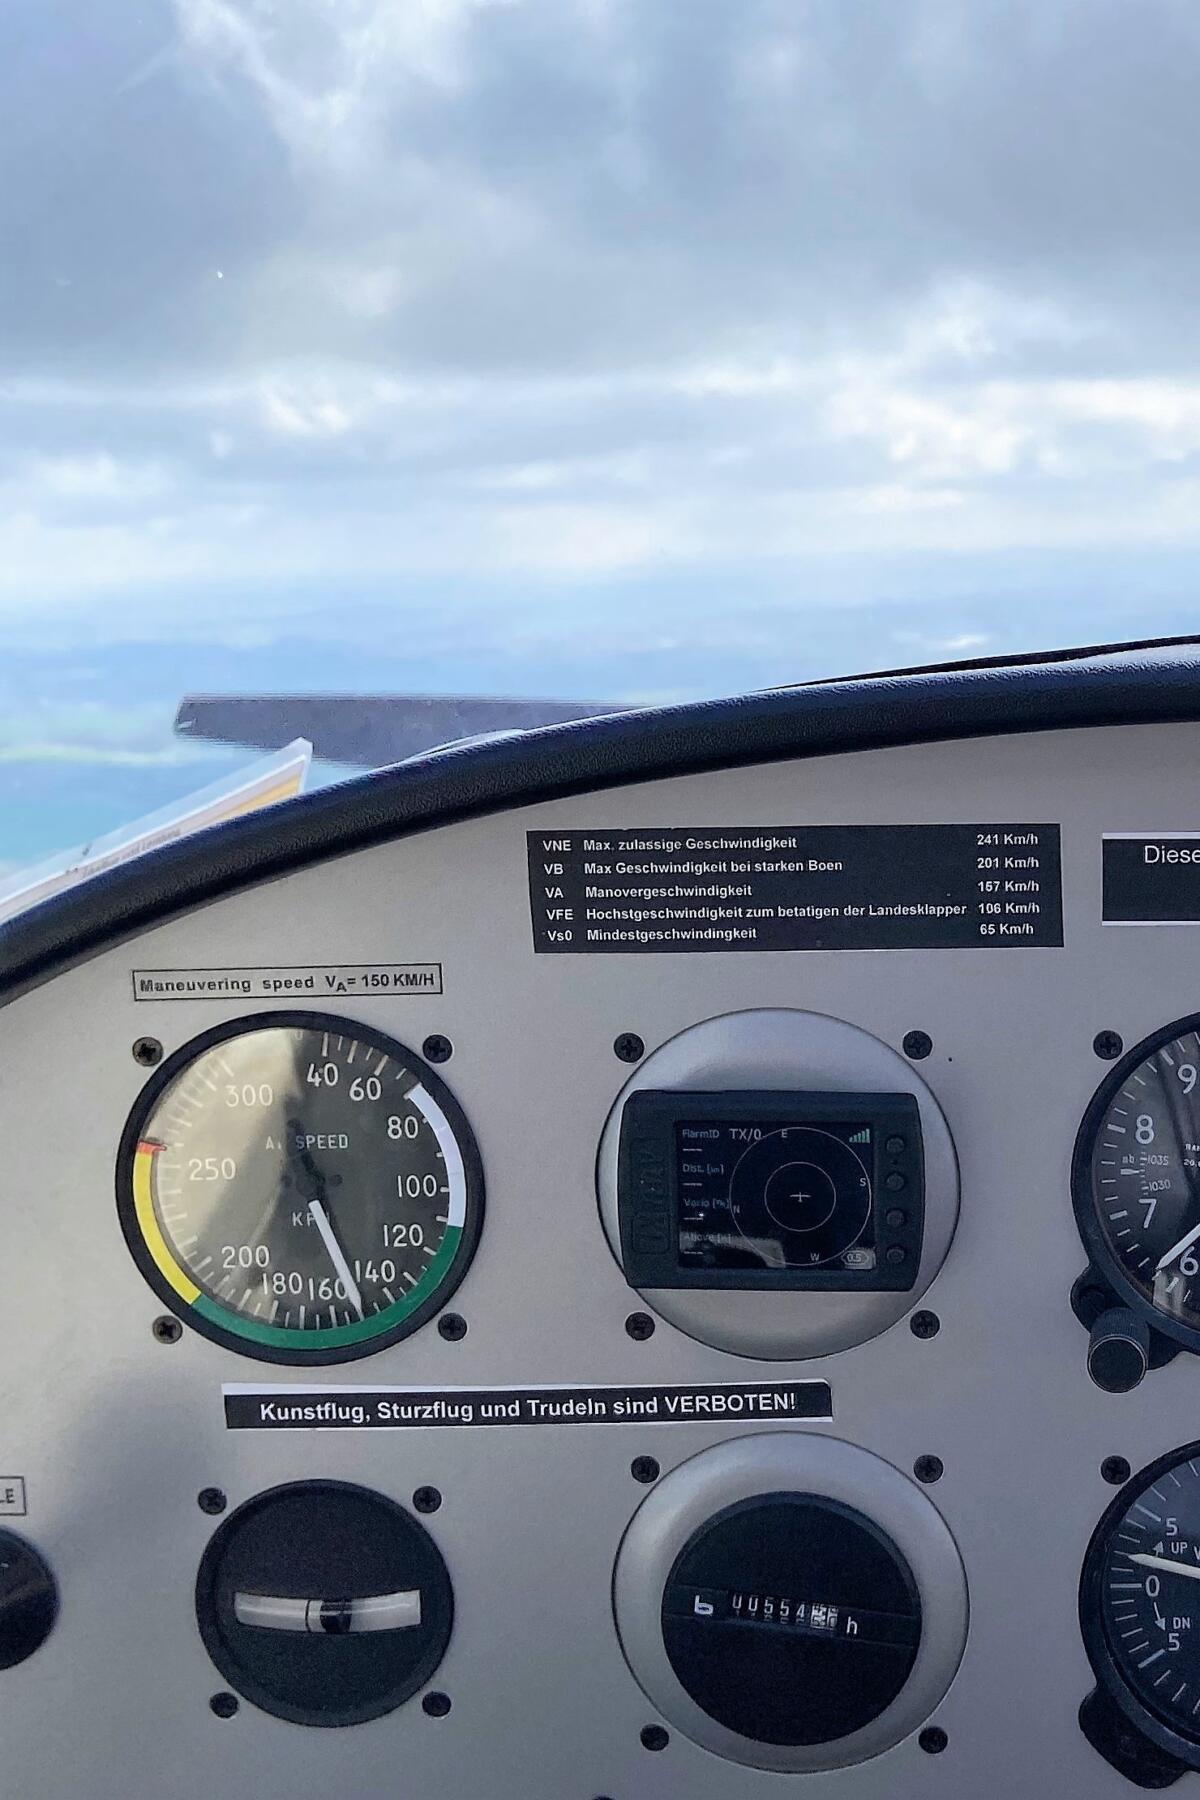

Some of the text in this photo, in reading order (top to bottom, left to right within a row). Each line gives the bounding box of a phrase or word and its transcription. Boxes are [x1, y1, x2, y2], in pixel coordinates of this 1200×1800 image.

[542, 839, 572, 852] VNE
[618, 837, 682, 854] zulassige
[685, 836, 798, 853] Geschwindigkeit
[976, 833, 1000, 846] 241
[1003, 832, 1039, 846] Km/h
[544, 855, 1040, 876] VB Max Geschwindigkeit bei starken Boen 201 Km/h
[545, 887, 564, 899] VA
[585, 883, 753, 900] Manovergeschwindigkeit
[1003, 879, 1040, 894] Km/h
[546, 901, 1041, 922] VFE Hochstgeschwindigkeit zum betatigen der Landesklapper 106 Km/h
[587, 926, 757, 943] Mindestgeschwindingkeit
[979, 923, 996, 936] 65
[999, 922, 1034, 936] Km/h
[140, 977, 251, 994] Maneuvering
[262, 975, 314, 992] speed
[361, 974, 390, 988] 150
[393, 972, 435, 988] KM/H
[306, 1062, 339, 1088] 40
[1177, 1063, 1198, 1094] 9
[225, 1084, 273, 1107] 300
[349, 1077, 382, 1102] 60
[387, 1116, 419, 1140] 80
[1134, 1114, 1155, 1144] 8
[296, 1135, 349, 1150] SPEED
[188, 1158, 236, 1181] 250
[397, 1175, 437, 1199] 100
[1138, 1198, 1157, 1229] 7
[383, 1224, 423, 1248] 120
[221, 1244, 270, 1270] 200
[1178, 1245, 1199, 1277] 6
[355, 1259, 396, 1283] 140
[262, 1272, 303, 1295] 180
[308, 1277, 348, 1300] 160
[260, 1392, 797, 1423] Kunstflug, Sturzflug und Trudeln sind VERBOTEN!
[1165, 1518, 1178, 1537] 5
[1171, 1542, 1188, 1554] UP
[1145, 1575, 1160, 1597] 0
[1172, 1616, 1191, 1630] DN
[1167, 1632, 1181, 1651] 5
